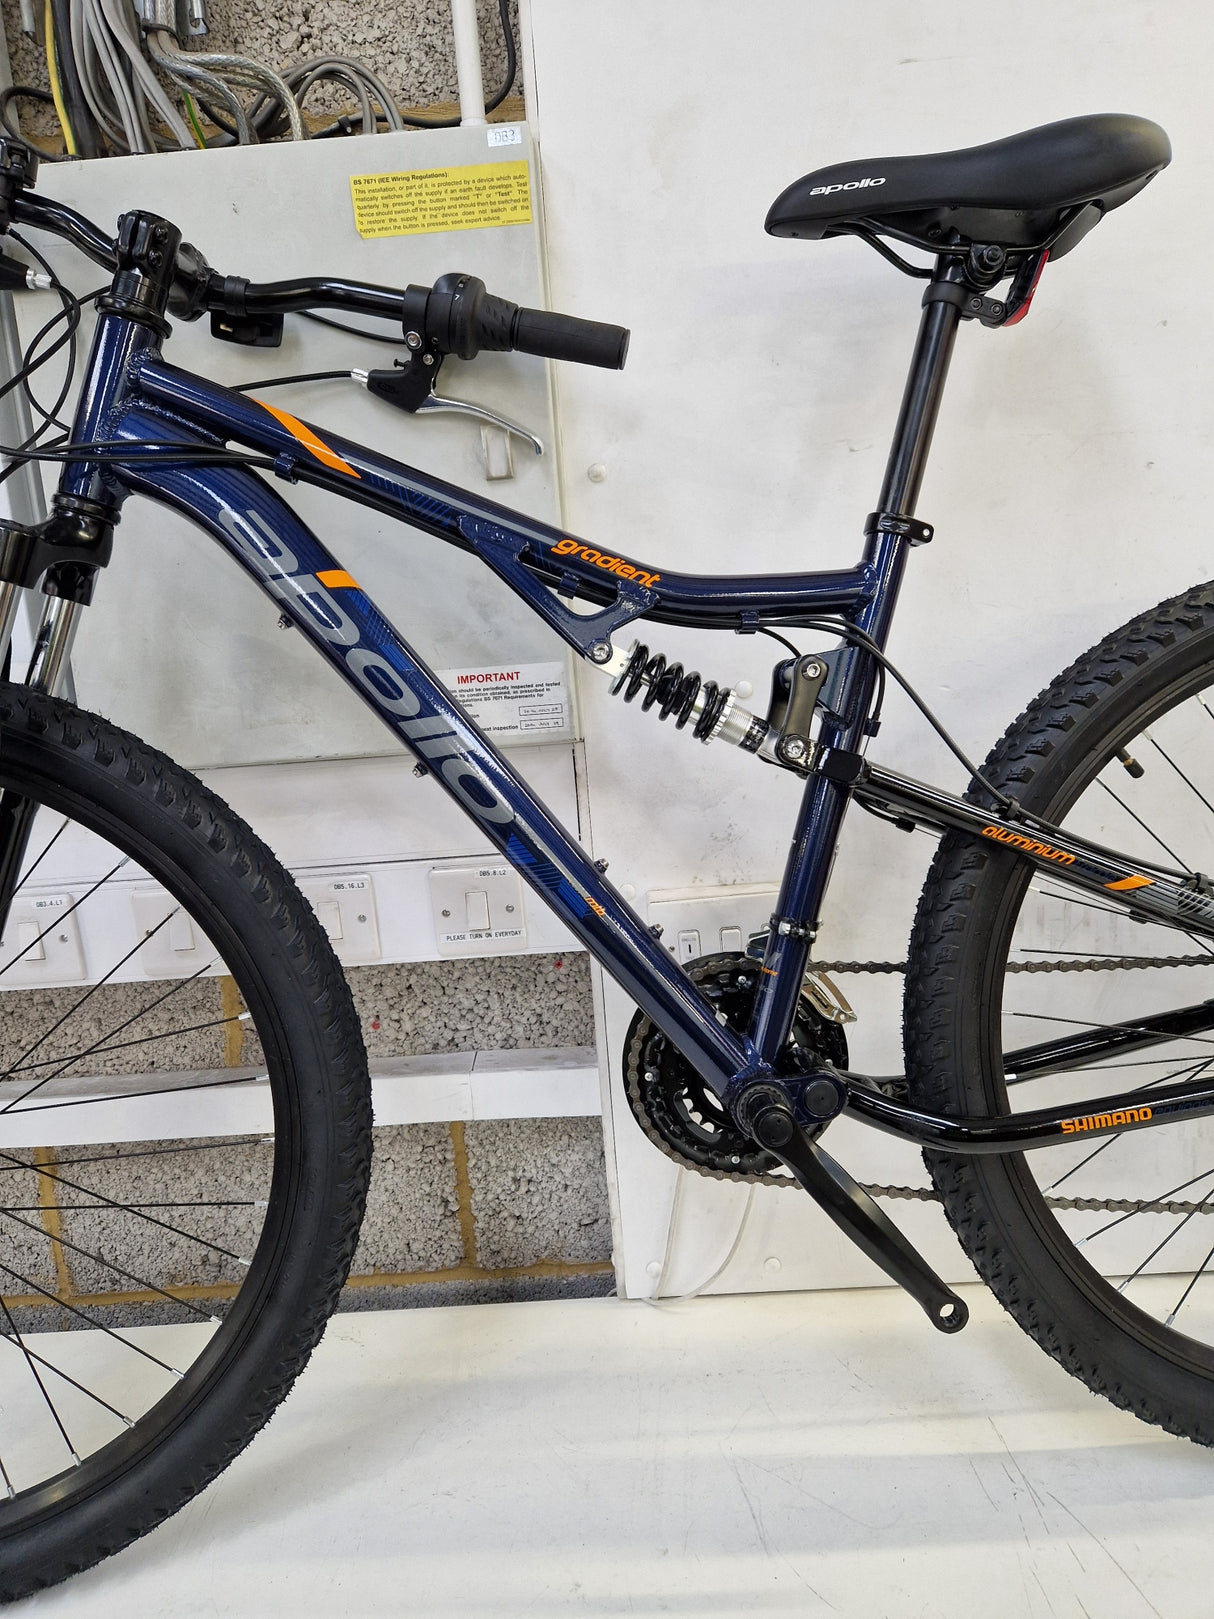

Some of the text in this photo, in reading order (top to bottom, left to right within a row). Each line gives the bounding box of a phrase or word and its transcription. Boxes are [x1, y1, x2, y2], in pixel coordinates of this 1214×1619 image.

[437, 180, 462, 188] protected
[810, 178, 886, 196] apollo
[550, 539, 660, 588] gradient
[217, 508, 515, 824] apollo
[457, 672, 520, 684] IMPORTANT
[982, 826, 1076, 866] aluminium
[1060, 1108, 1152, 1134] SHIMANO
